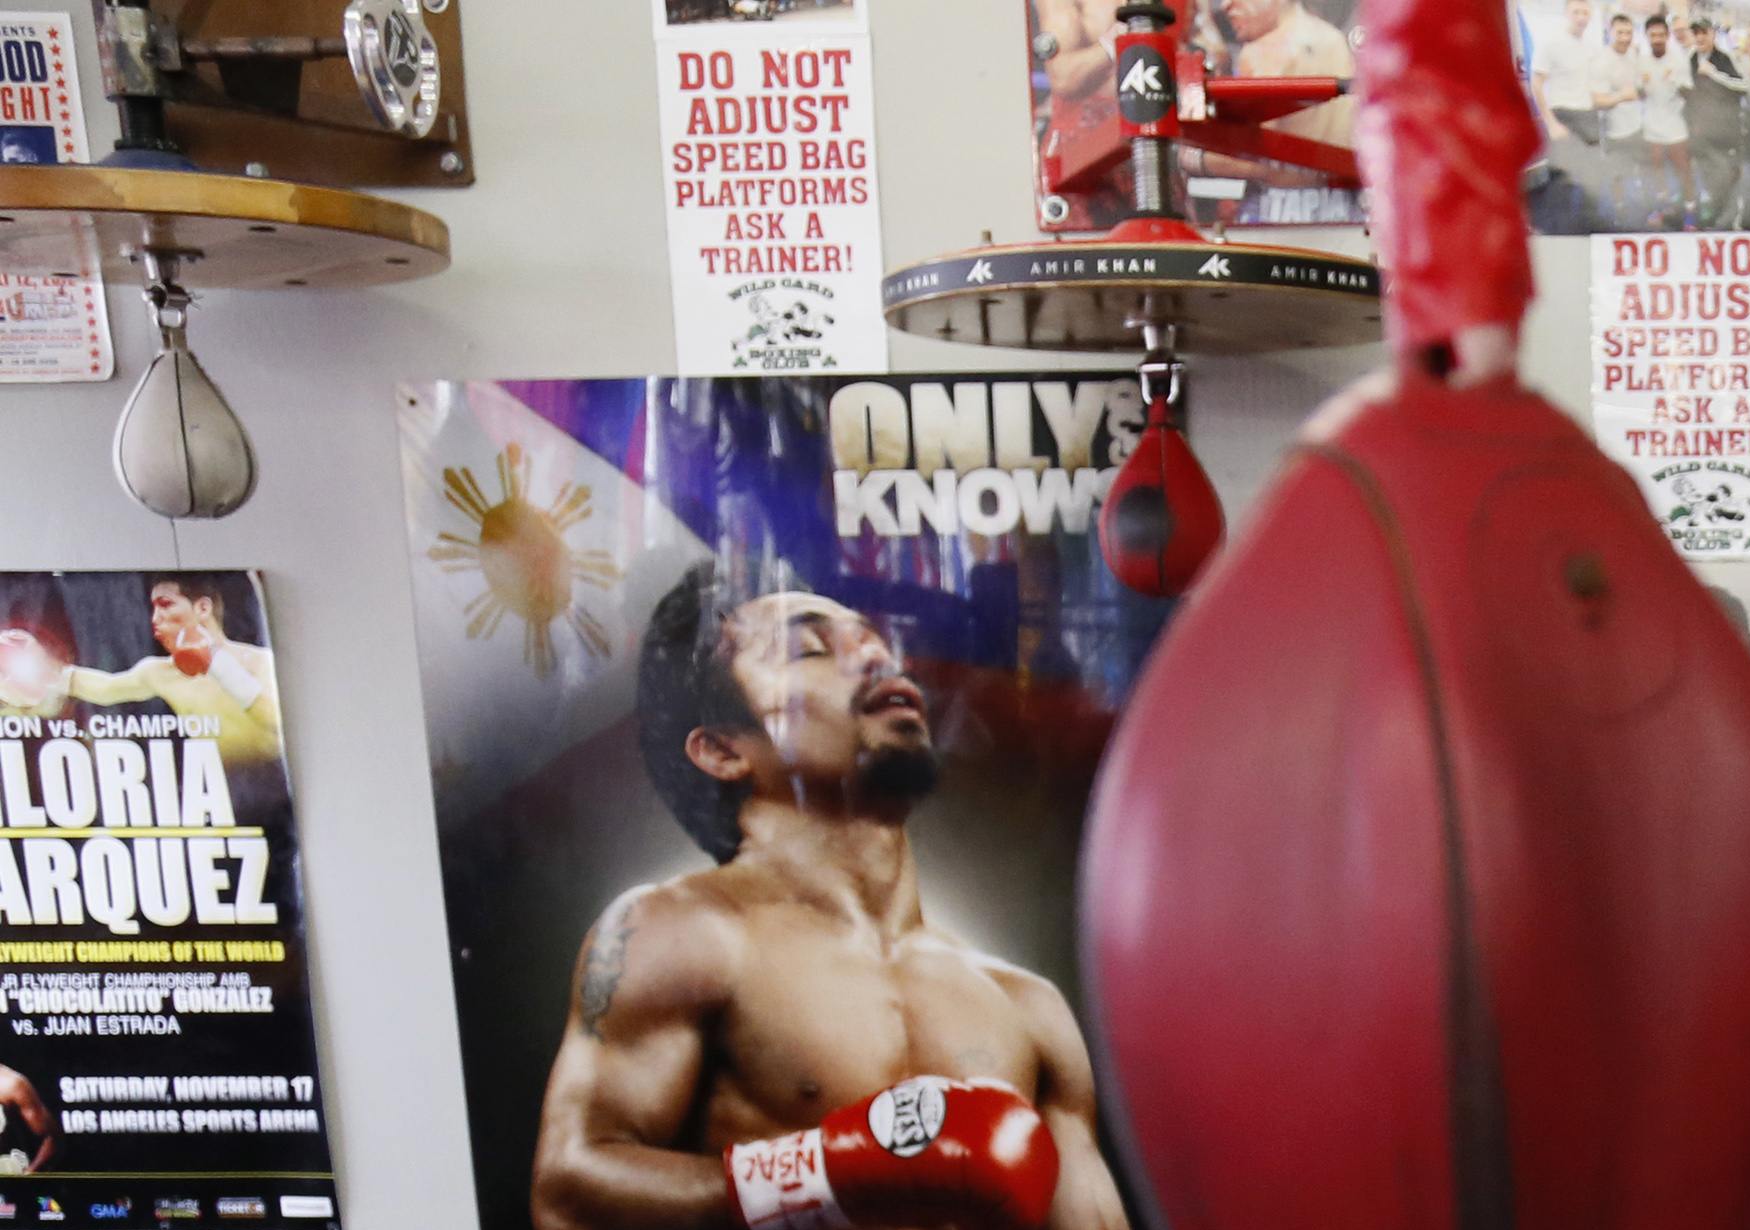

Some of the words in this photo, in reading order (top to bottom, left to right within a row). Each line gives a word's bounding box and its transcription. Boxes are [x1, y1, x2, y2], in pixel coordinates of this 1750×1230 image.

[0, 40, 48, 82] OD
[678, 51, 734, 90] DO
[761, 49, 852, 88] NOT
[687, 95, 849, 135] ADJUST
[673, 142, 787, 173] SPEED
[800, 139, 866, 170] BAG
[675, 177, 868, 208] PLATFORMS
[725, 213, 786, 240] ASK
[805, 212, 824, 239] A
[701, 245, 853, 274] TRAINER!
[1612, 238, 1669, 276] DO
[1030, 259, 1085, 276] AMIR
[1097, 258, 1157, 274] KHAN
[1270, 265, 1318, 281] AMIR
[1327, 270, 1369, 288] KHAN
[728, 279, 776, 301] WILD
[782, 279, 834, 299] CARD
[1603, 326, 1719, 357] SPEED
[1653, 397, 1713, 423] ASK
[829, 382, 1111, 470] ONLY
[1652, 462, 1701, 482] WILD
[90, 715, 221, 738] CHAMPION
[76, 941, 171, 962] CHAMPIONS
[172, 941, 193, 962] OF
[194, 941, 225, 961] THE
[225, 941, 285, 962] WORLD
[22, 973, 100, 989] FLYWEIGHT
[172, 986, 274, 1013] GONZALEZ
[44, 1016, 91, 1036] JUAN
[96, 1015, 181, 1036] ESTRADA
[59, 1076, 172, 1103] SATURDAY,
[173, 1076, 289, 1101] NOVEMBER
[290, 1076, 314, 1101] 17
[61, 1109, 98, 1134] LOS
[100, 1109, 180, 1133] ANGELES
[182, 1109, 257, 1133] SPORTS
[259, 1109, 319, 1132] ARENA
